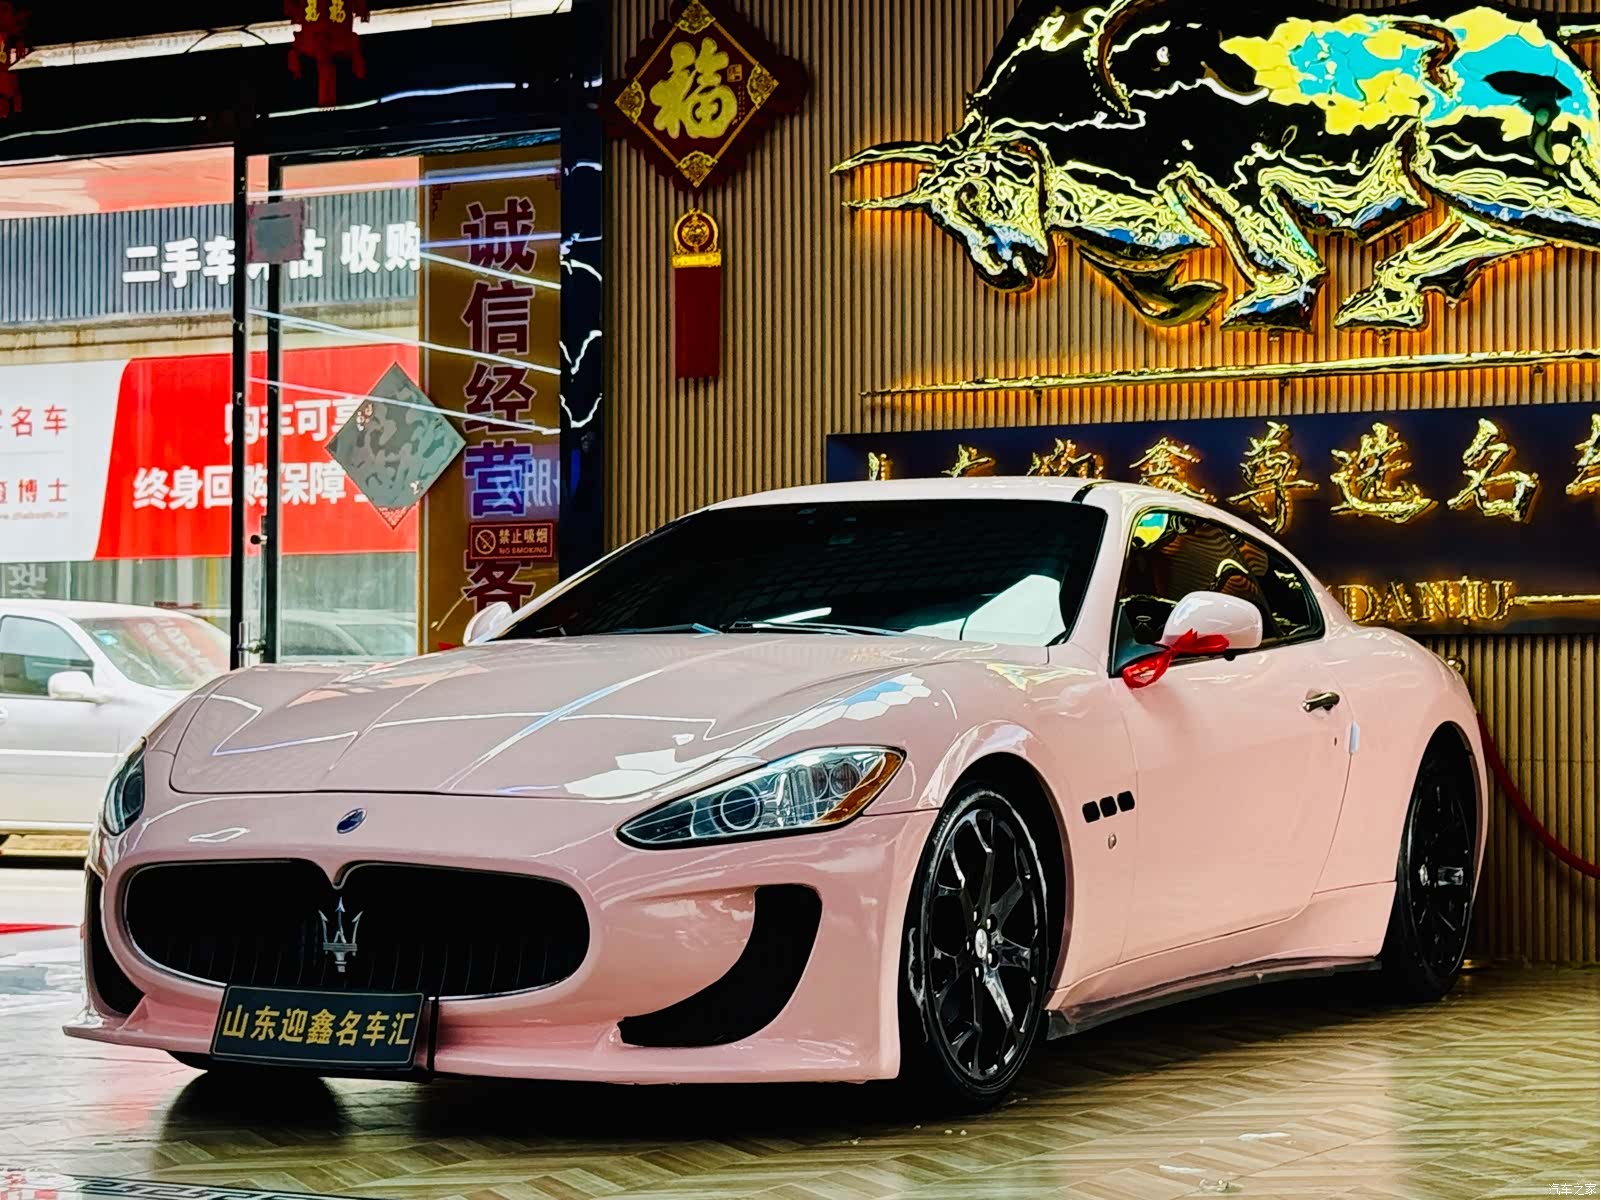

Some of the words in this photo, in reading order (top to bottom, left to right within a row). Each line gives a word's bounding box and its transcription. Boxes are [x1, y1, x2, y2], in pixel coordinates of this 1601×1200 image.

[649, 37, 738, 139] 福
[341, 221, 420, 274] 收购
[0, 404, 67, 437] 名车
[499, 528, 548, 544] 禁止吸烟
[512, 546, 547, 554] SMOKING
[222, 1004, 415, 1046] 山东迎鑫名车汇
